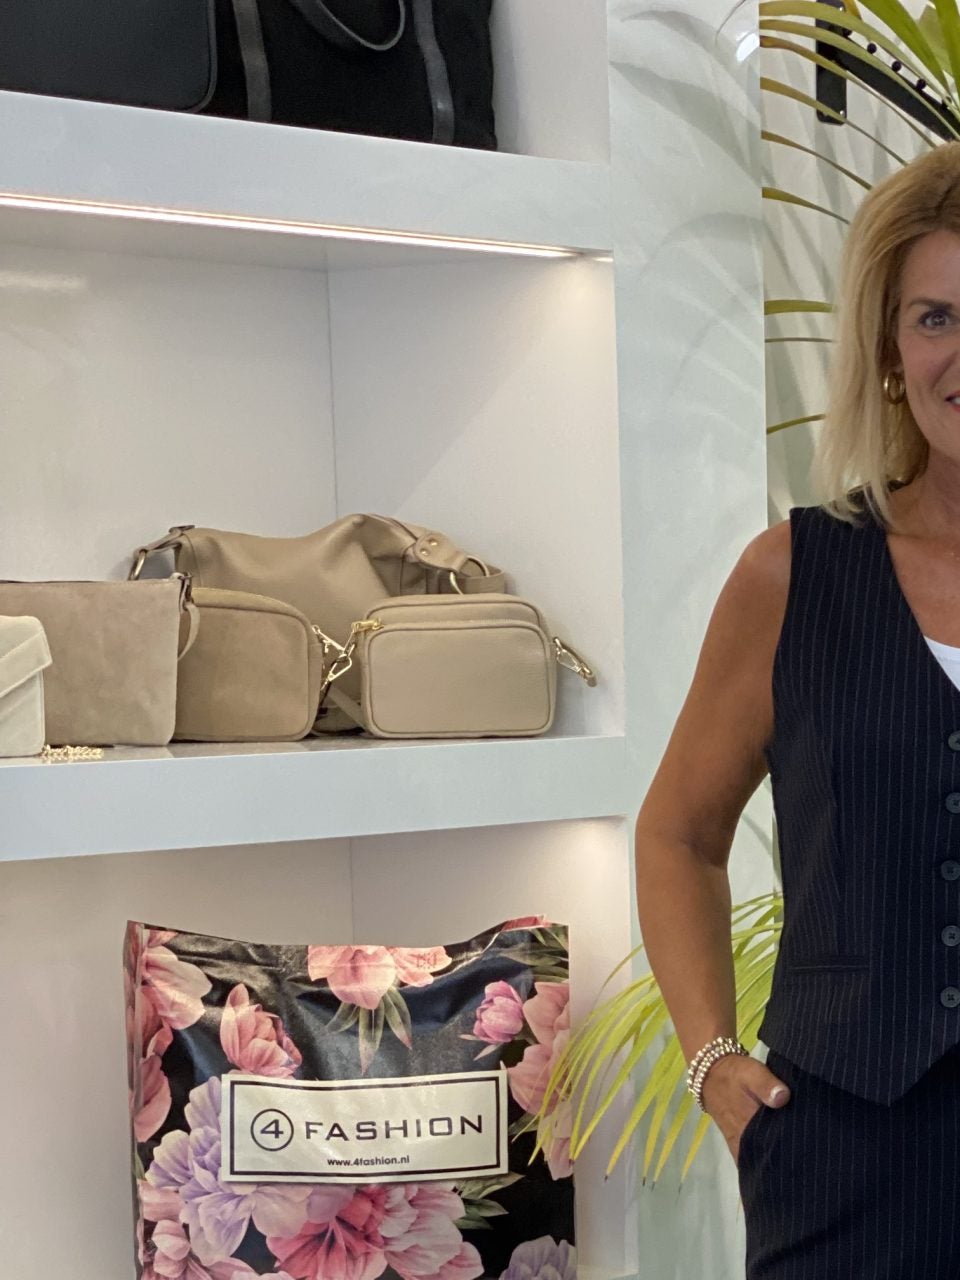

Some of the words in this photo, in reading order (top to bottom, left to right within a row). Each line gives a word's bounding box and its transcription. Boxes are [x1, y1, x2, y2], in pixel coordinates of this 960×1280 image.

[260, 1118, 284, 1139] 4
[305, 1114, 483, 1141] FASHION
[327, 1154, 410, 1167] www.4fashion.nl
